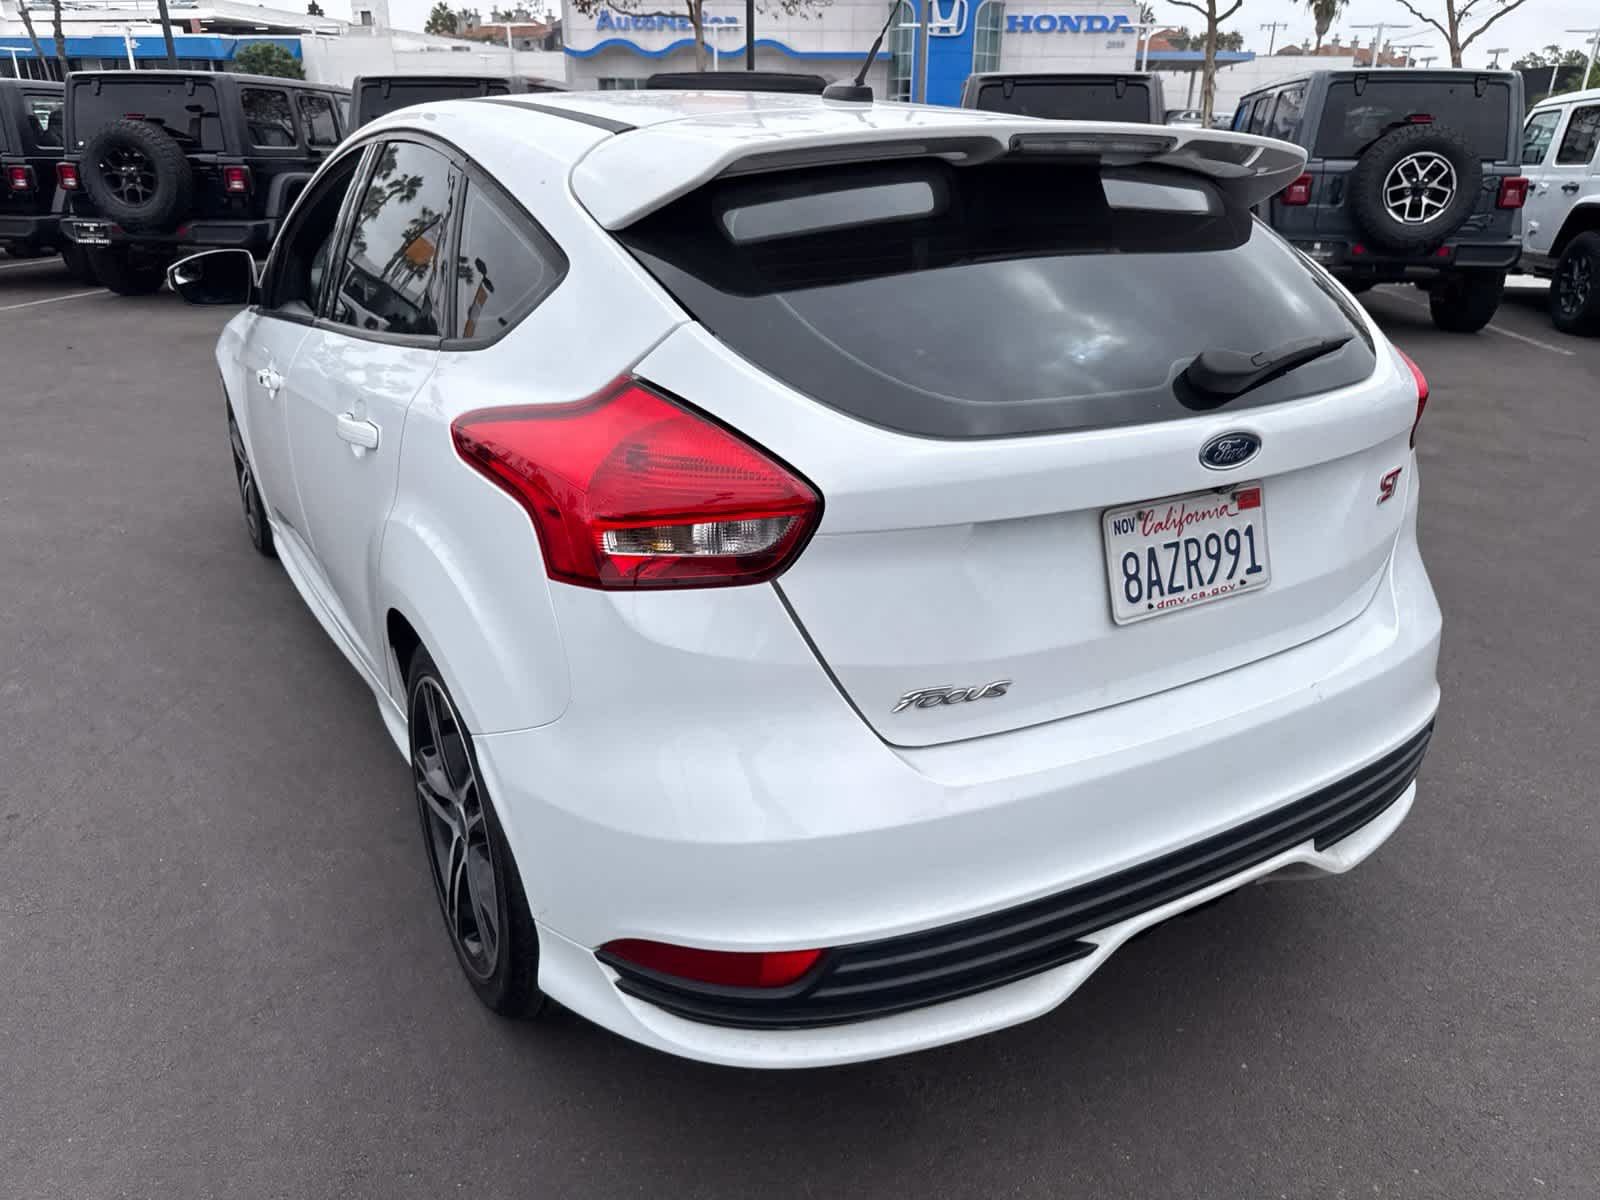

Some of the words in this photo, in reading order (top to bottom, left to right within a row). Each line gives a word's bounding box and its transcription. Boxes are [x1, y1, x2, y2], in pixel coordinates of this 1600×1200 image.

[597, 10, 738, 31] AutoNaion
[1007, 15, 1135, 33] HONDA
[1214, 439, 1249, 462] Ford
[1376, 465, 1403, 505] ST
[1113, 517, 1136, 536] NOV
[1141, 503, 1239, 537] California
[1122, 524, 1263, 604] 8AZR991
[1157, 583, 1236, 609] dmv.ca.gov
